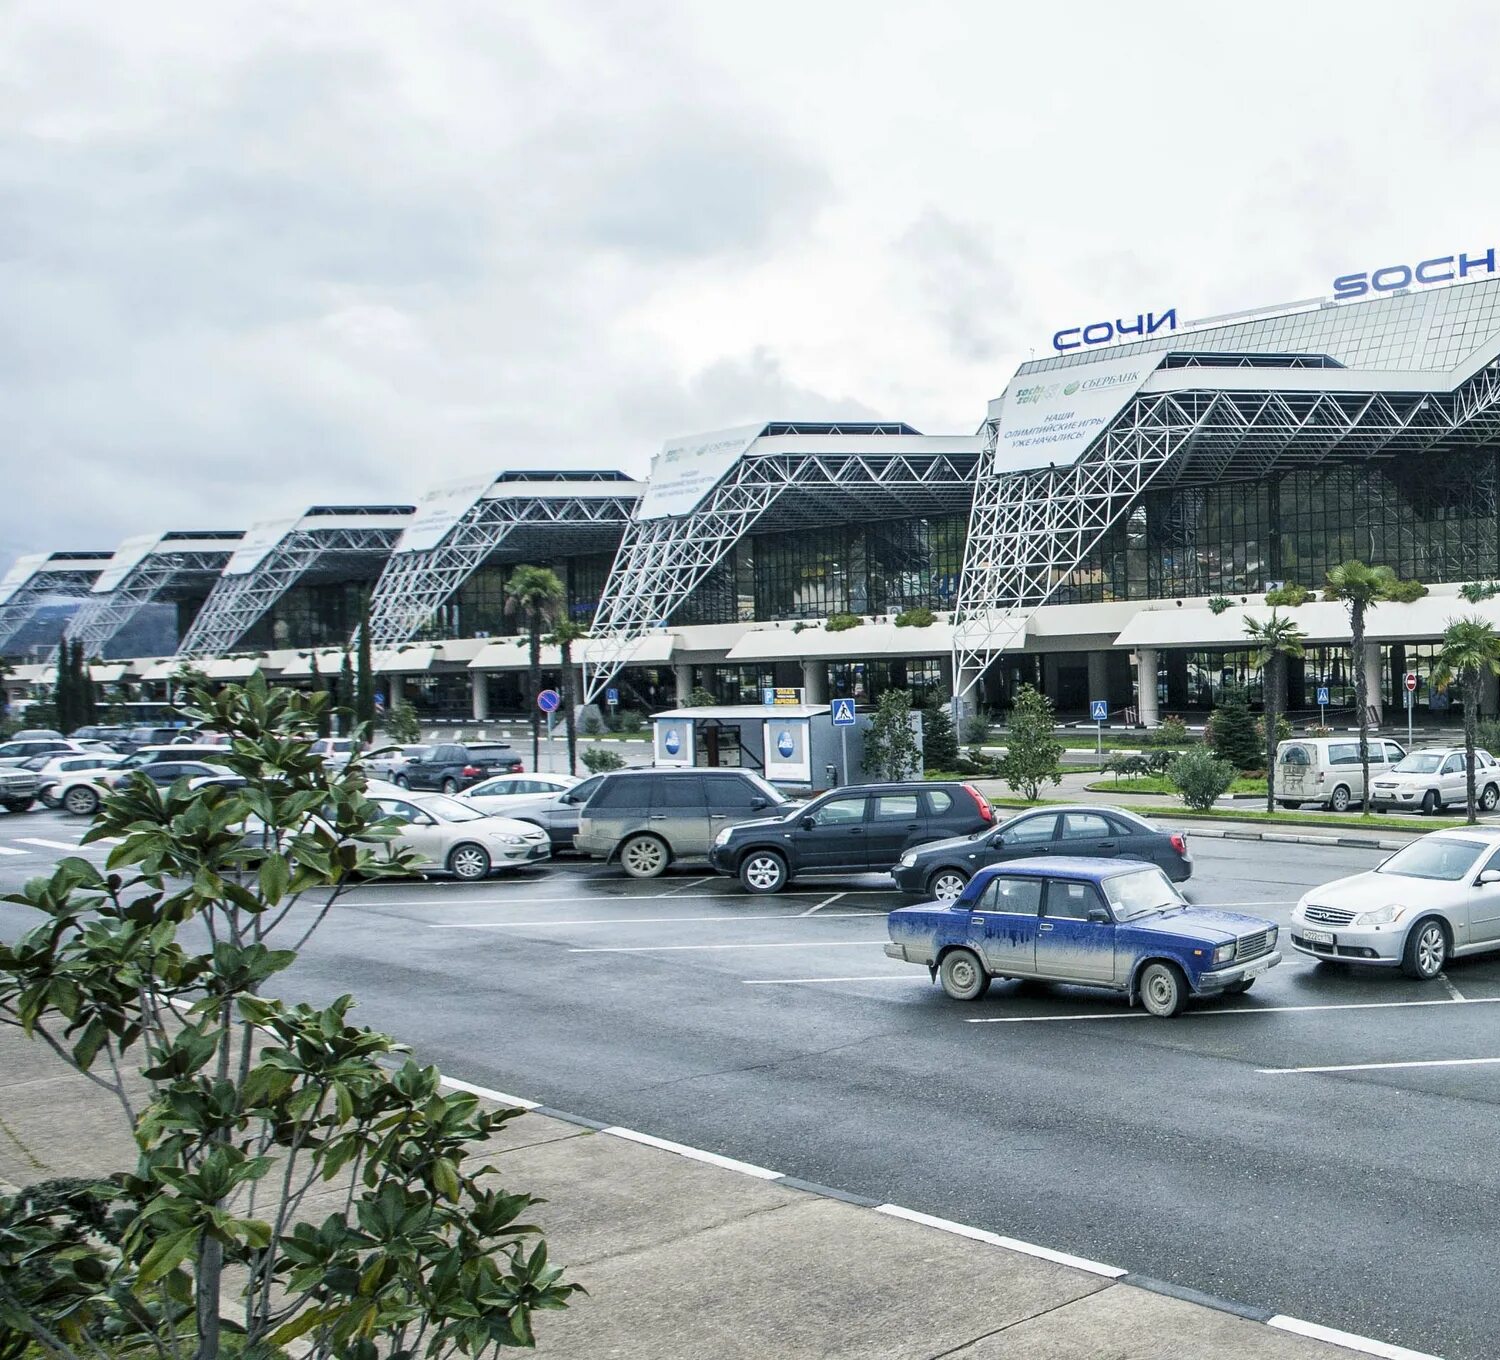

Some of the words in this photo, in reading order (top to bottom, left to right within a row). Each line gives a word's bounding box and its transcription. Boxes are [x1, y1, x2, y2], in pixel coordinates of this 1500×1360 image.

[1053, 308, 1176, 350] СОЧИ
[1082, 371, 1140, 389] СБЕРБАНК
[1044, 411, 1075, 423] НАШИ
[1004, 421, 1078, 439] ОЛИМПИЙСКИЕ
[1078, 417, 1106, 428] ИГРЫ
[1012, 438, 1031, 449] УЖЕ
[1031, 431, 1086, 445] НАЧАЛИСЬ!
